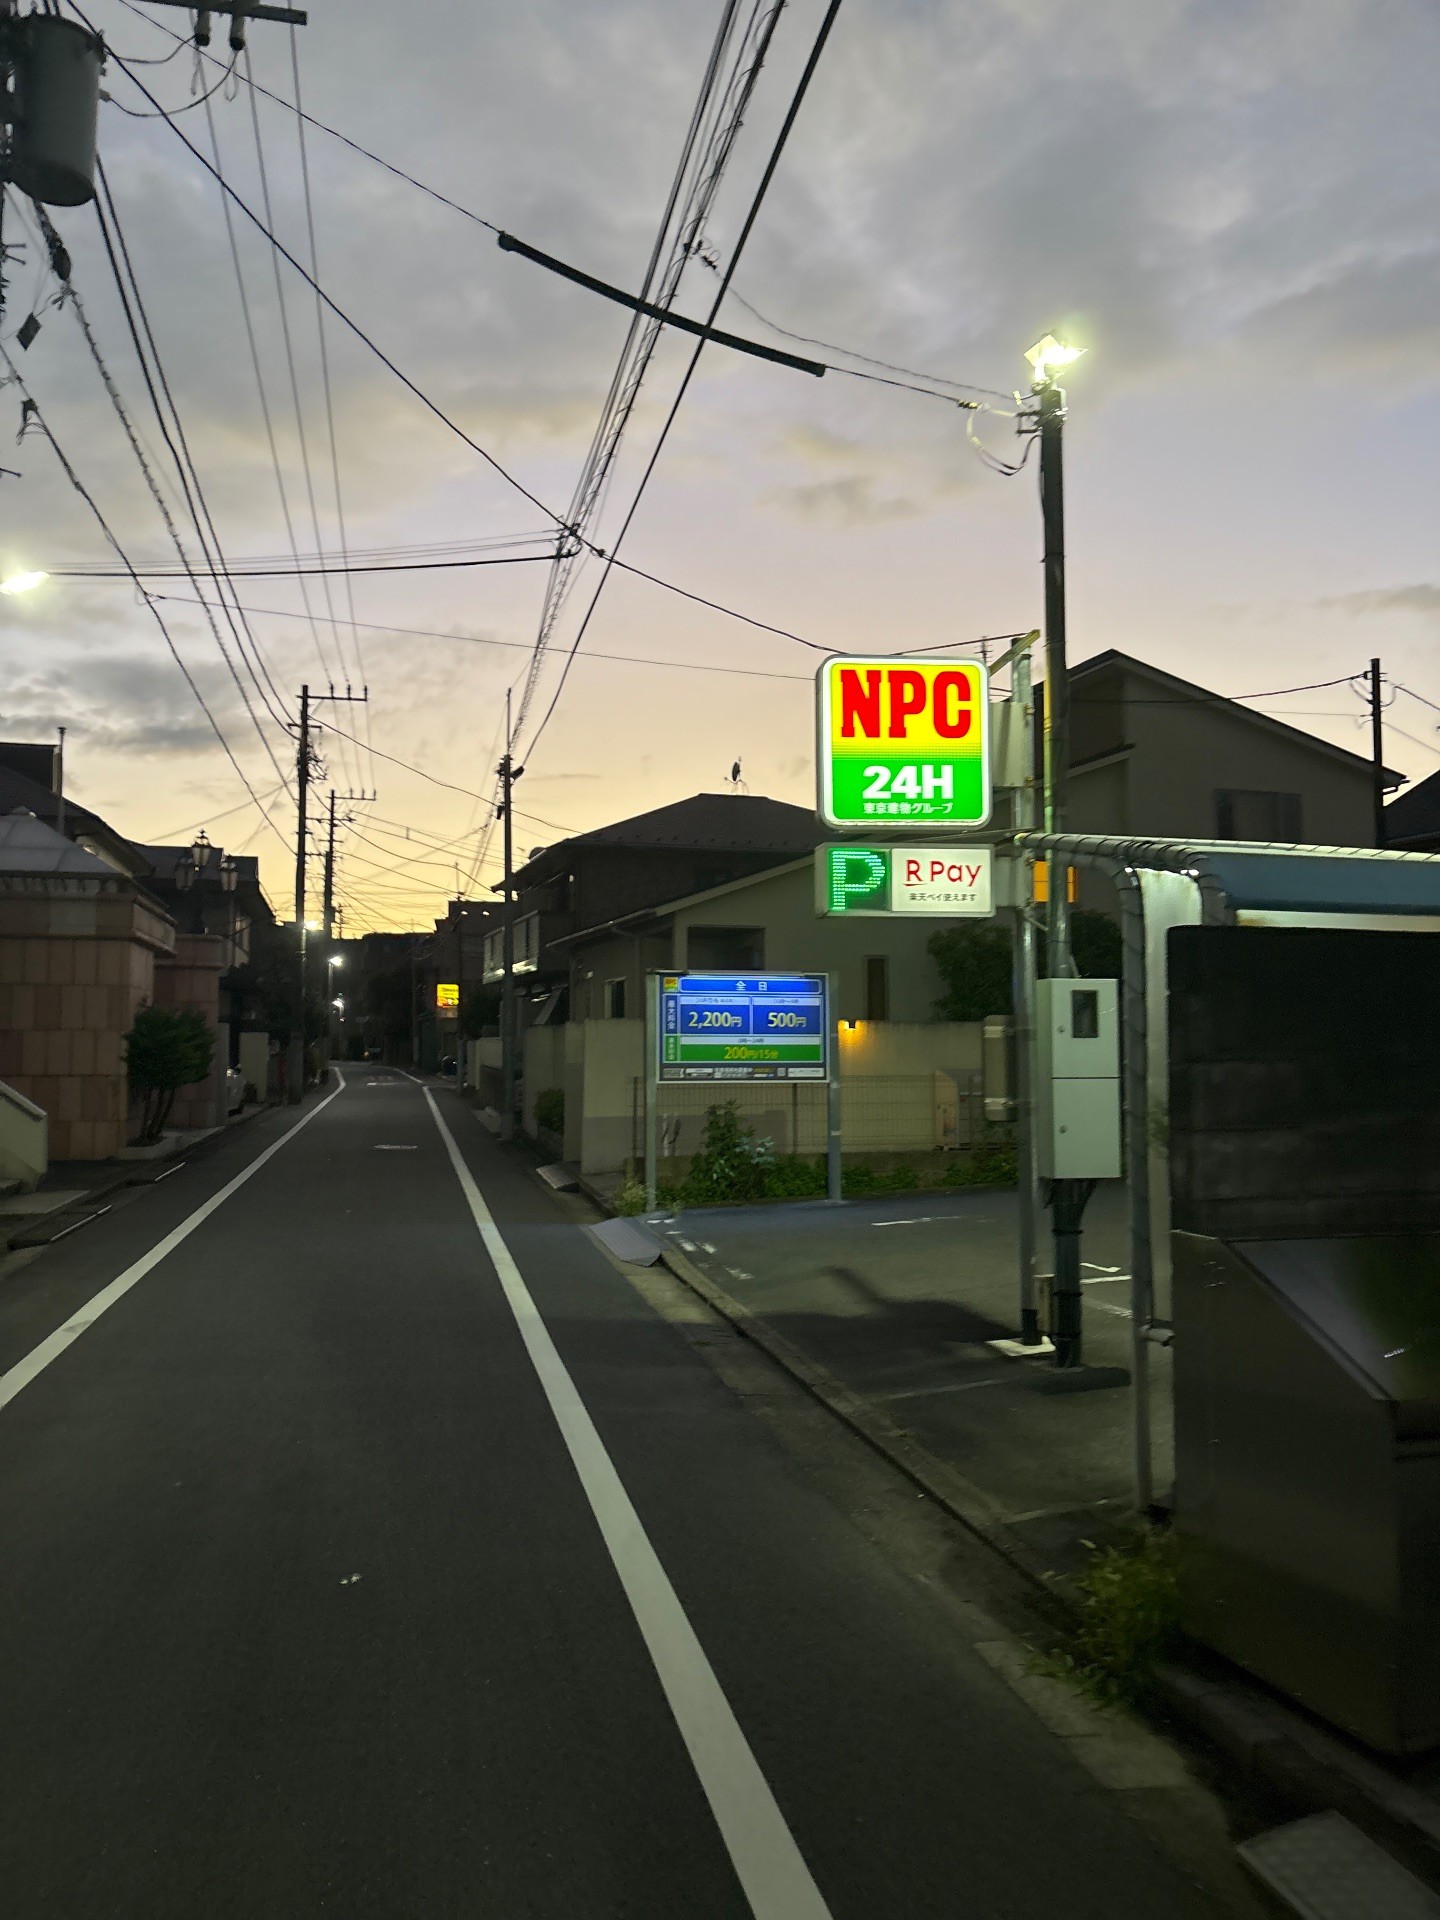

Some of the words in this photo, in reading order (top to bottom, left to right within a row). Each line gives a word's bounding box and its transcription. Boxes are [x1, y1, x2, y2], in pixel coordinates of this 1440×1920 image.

[840, 669, 971, 738] NPC
[862, 764, 954, 800] 24H
[862, 802, 953, 815] 東京建物グループ
[929, 859, 982, 887] Pay
[688, 1011, 743, 1028] 2,200円
[767, 1012, 808, 1028] 500円
